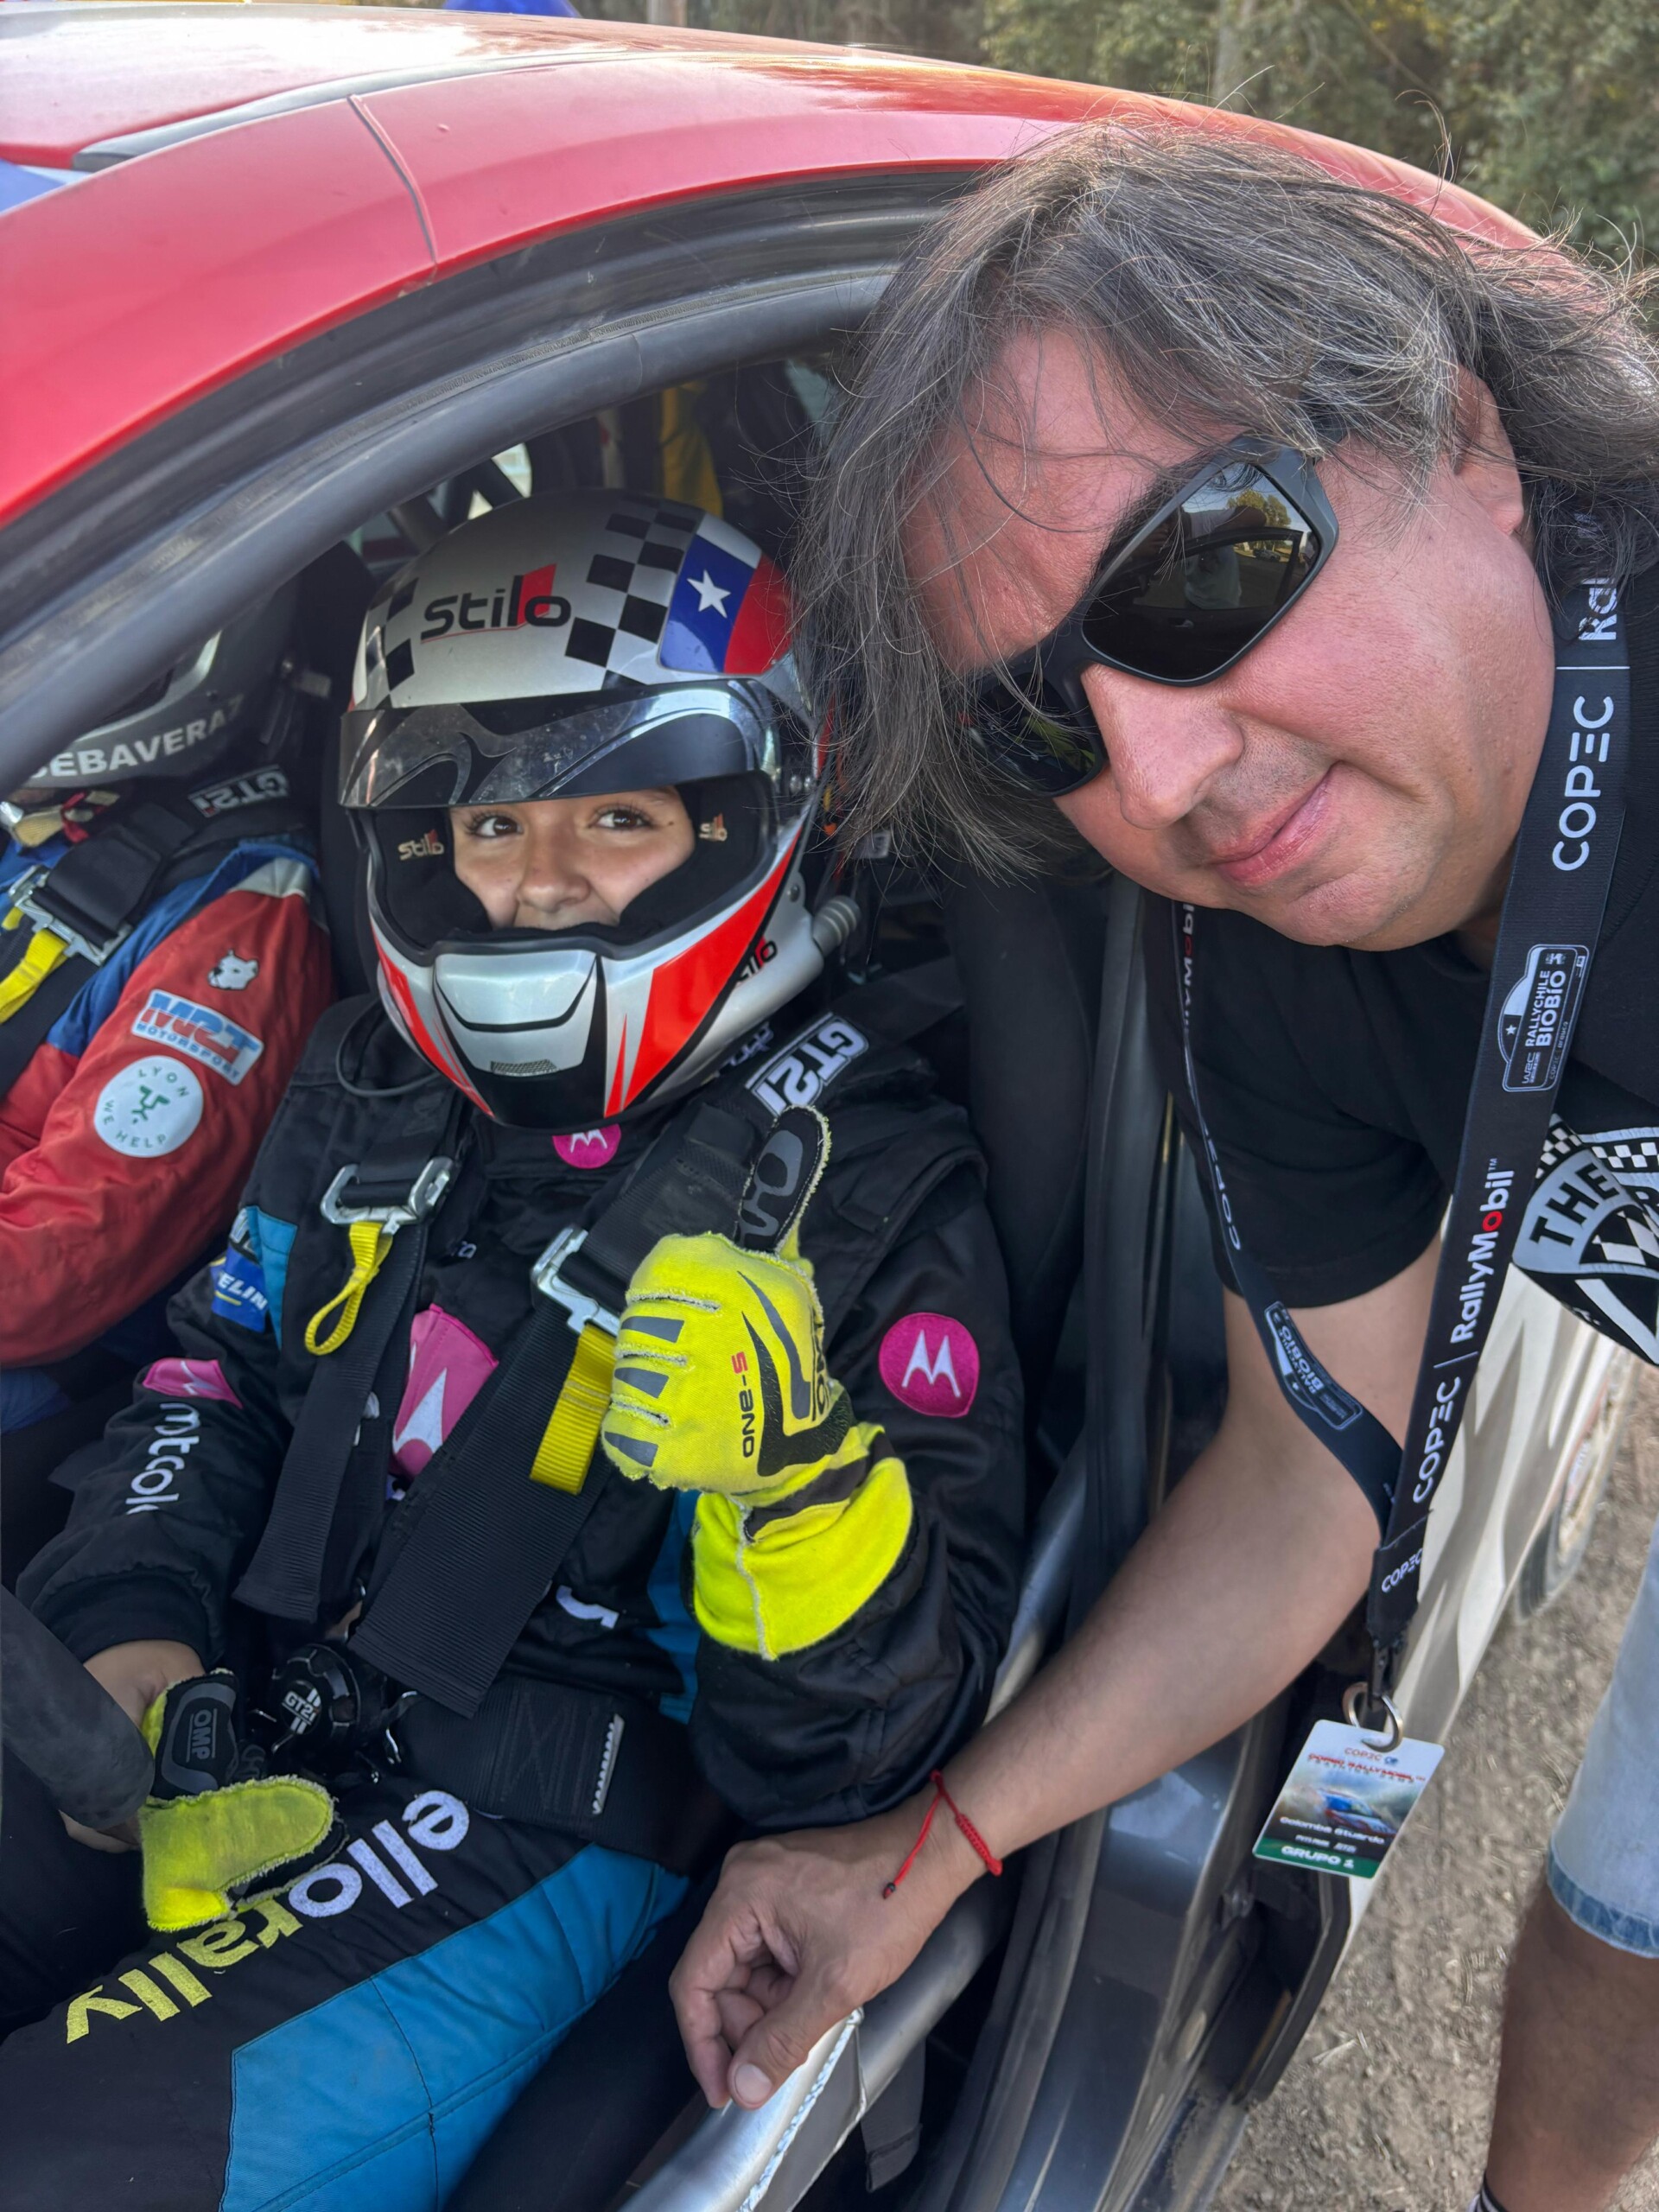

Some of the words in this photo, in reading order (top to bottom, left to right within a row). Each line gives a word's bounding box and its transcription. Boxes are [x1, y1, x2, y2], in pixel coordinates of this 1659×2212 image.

[420, 564, 572, 641] stilo
[1552, 696, 1615, 871] COPEC
[136, 1021, 240, 1079] MOTORSPORT
[137, 1065, 190, 1098] LYON
[115, 1129, 168, 1148] HELP
[1529, 1162, 1621, 1247] THE
[730, 1351, 754, 1459] ONE-S
[1412, 1376, 1462, 1503] COPEC
[191, 1709, 213, 1760] OMP
[1281, 1846, 1342, 1866] GRUPO
[1344, 1858, 1355, 1869] 1
